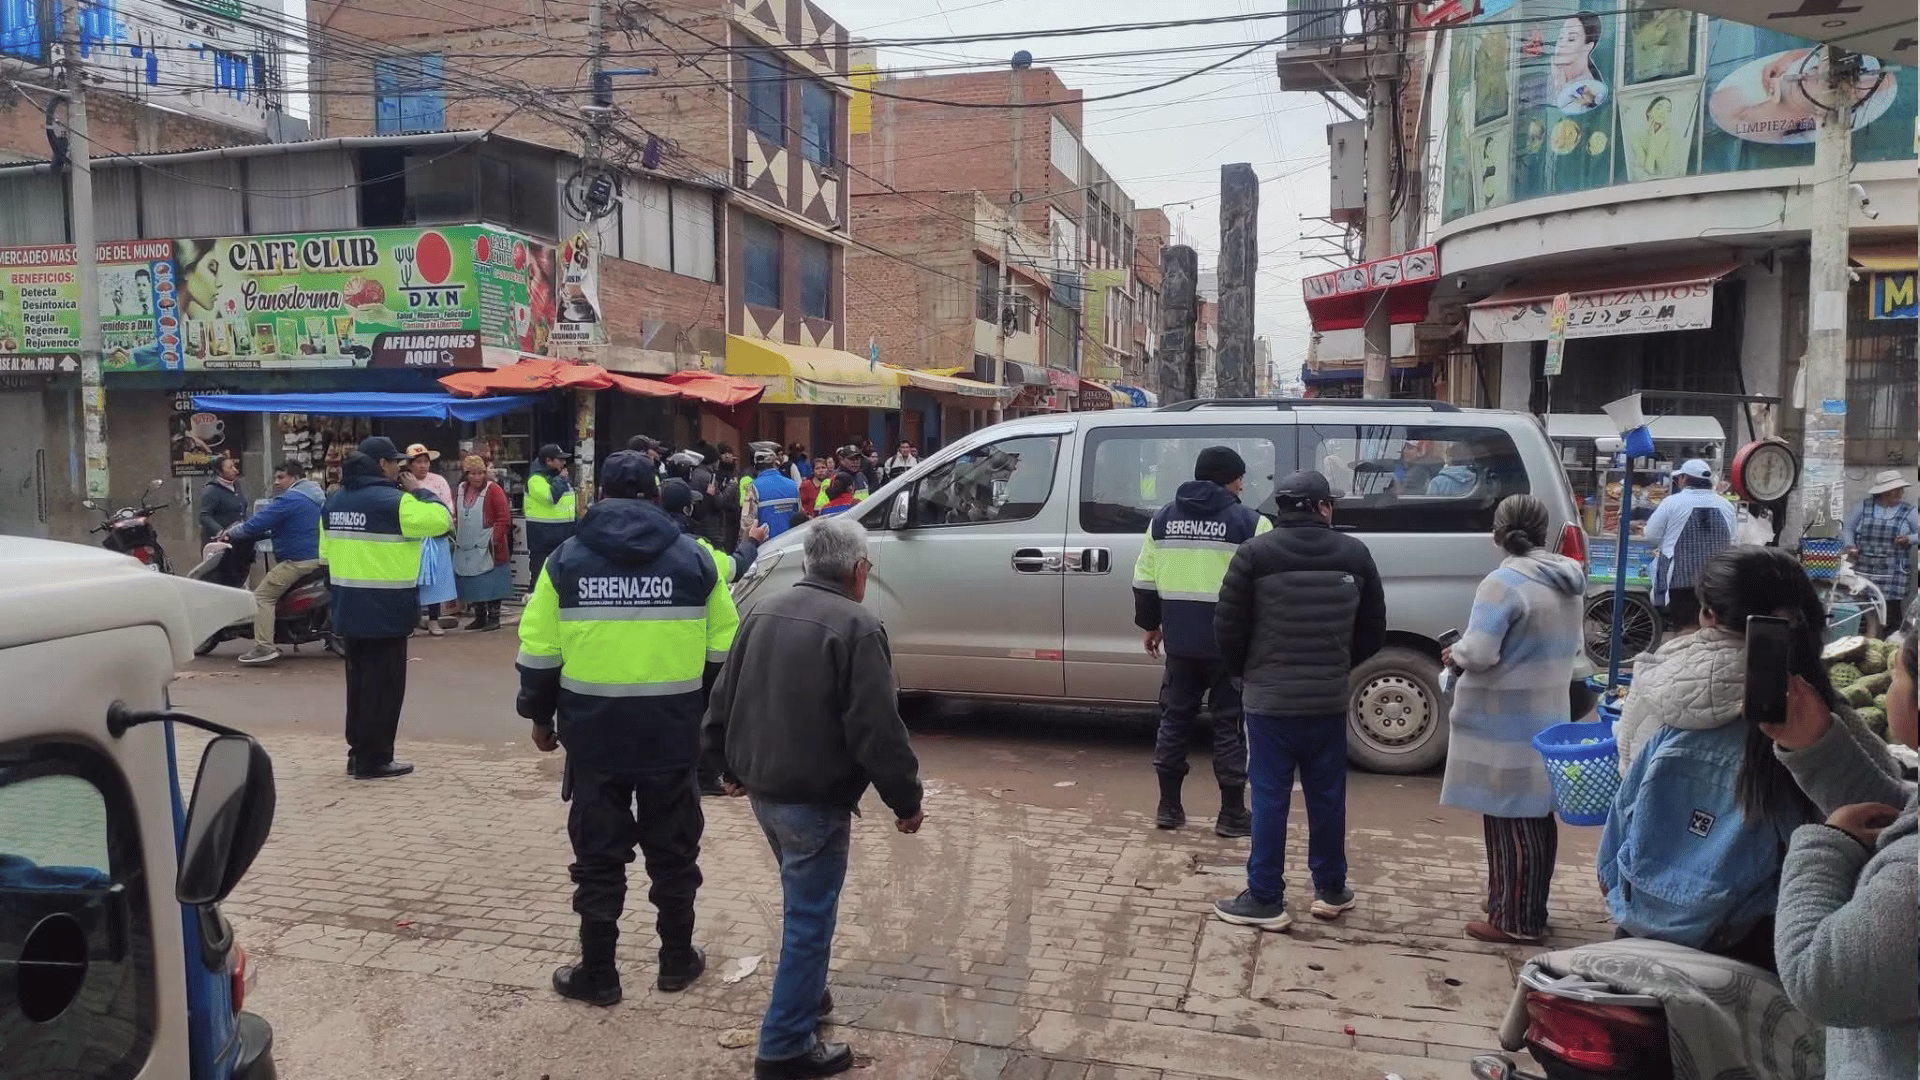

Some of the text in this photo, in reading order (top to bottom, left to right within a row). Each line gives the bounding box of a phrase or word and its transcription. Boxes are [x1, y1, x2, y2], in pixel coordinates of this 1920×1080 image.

[1736, 118, 1796, 134] LIMPIEZA
[50, 248, 71, 263] MAS
[113, 245, 131, 260] DEL
[133, 243, 169, 259] MUNDO
[229, 237, 379, 272] CAFE CLUB
[11, 272, 75, 285] BENEFICIOS:
[21, 287, 57, 297] Detecta
[241, 280, 341, 313] Ganoderma
[409, 291, 458, 307] DXN
[22, 299, 76, 310] Desintoxica
[23, 312, 55, 325] Regula
[25, 325, 69, 338] Regenera
[26, 338, 79, 350] Rejuvenece
[383, 334, 476, 350] AFILIACIONES
[37, 357, 55, 371] PISO
[404, 350, 438, 365] AQUI
[329, 511, 366, 527] SERENAZGO
[1165, 520, 1227, 537] SERENAZGO
[578, 576, 673, 599] SERENAZGO
